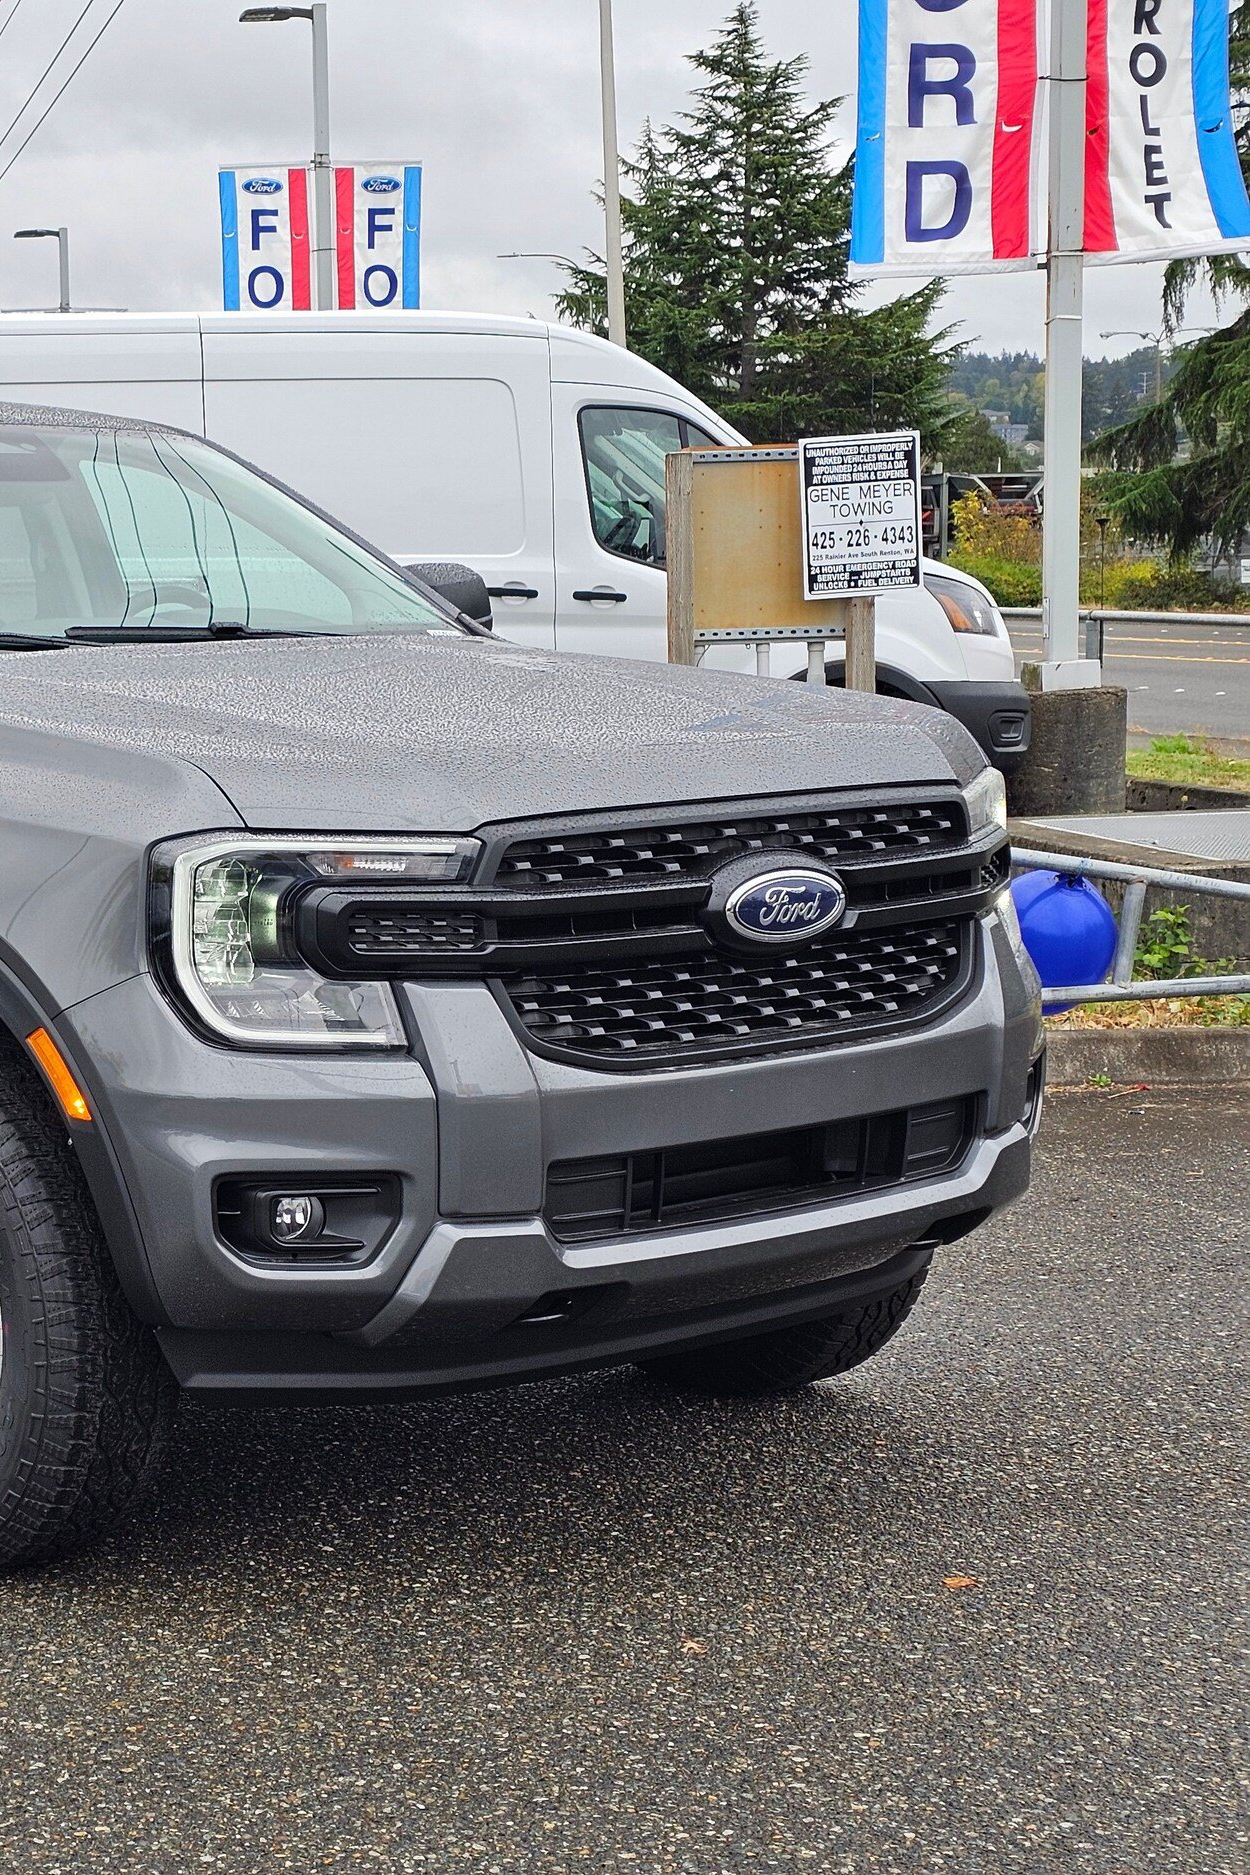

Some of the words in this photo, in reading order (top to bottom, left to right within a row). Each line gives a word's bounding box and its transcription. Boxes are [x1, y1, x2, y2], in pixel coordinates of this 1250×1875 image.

[905, 0, 977, 242] RD
[250, 179, 276, 193] Ford
[367, 178, 394, 191] Ford
[806, 446, 859, 458] UNAUTHORIZED
[859, 445, 870, 454] OR
[870, 442, 913, 453] IMPROPERLY
[815, 456, 842, 466] PARKED
[843, 454, 877, 464] VEHICLES
[877, 452, 894, 461] WILL
[894, 451, 905, 460] BE
[812, 464, 852, 475] IMPOUNDED
[852, 463, 862, 472] 24
[862, 462, 887, 471] HOURS
[887, 461, 893, 470] A
[893, 460, 908, 469] DAY
[812, 475, 822, 485] AT
[822, 473, 852, 484] OWNERS
[852, 472, 870, 481] RISK
[869, 471, 876, 480] &
[876, 469, 909, 480] EXPENSE
[810, 487, 850, 503] GENE
[859, 483, 913, 500] MEYER
[830, 500, 893, 518] TOWING
[825, 552, 846, 560] Rainier
[810, 566, 820, 575] 24
[821, 564, 844, 573] HOUR
[845, 561, 894, 572] EMERGENCY
[895, 559, 917, 568] ROAD
[817, 572, 850, 582] SERVICE
[860, 568, 911, 579] JUMPSTARTS
[813, 580, 849, 591] UNLOCKS
[858, 578, 877, 587] FUEL
[878, 576, 915, 586] DELIVERY
[759, 886, 821, 926] Ford
